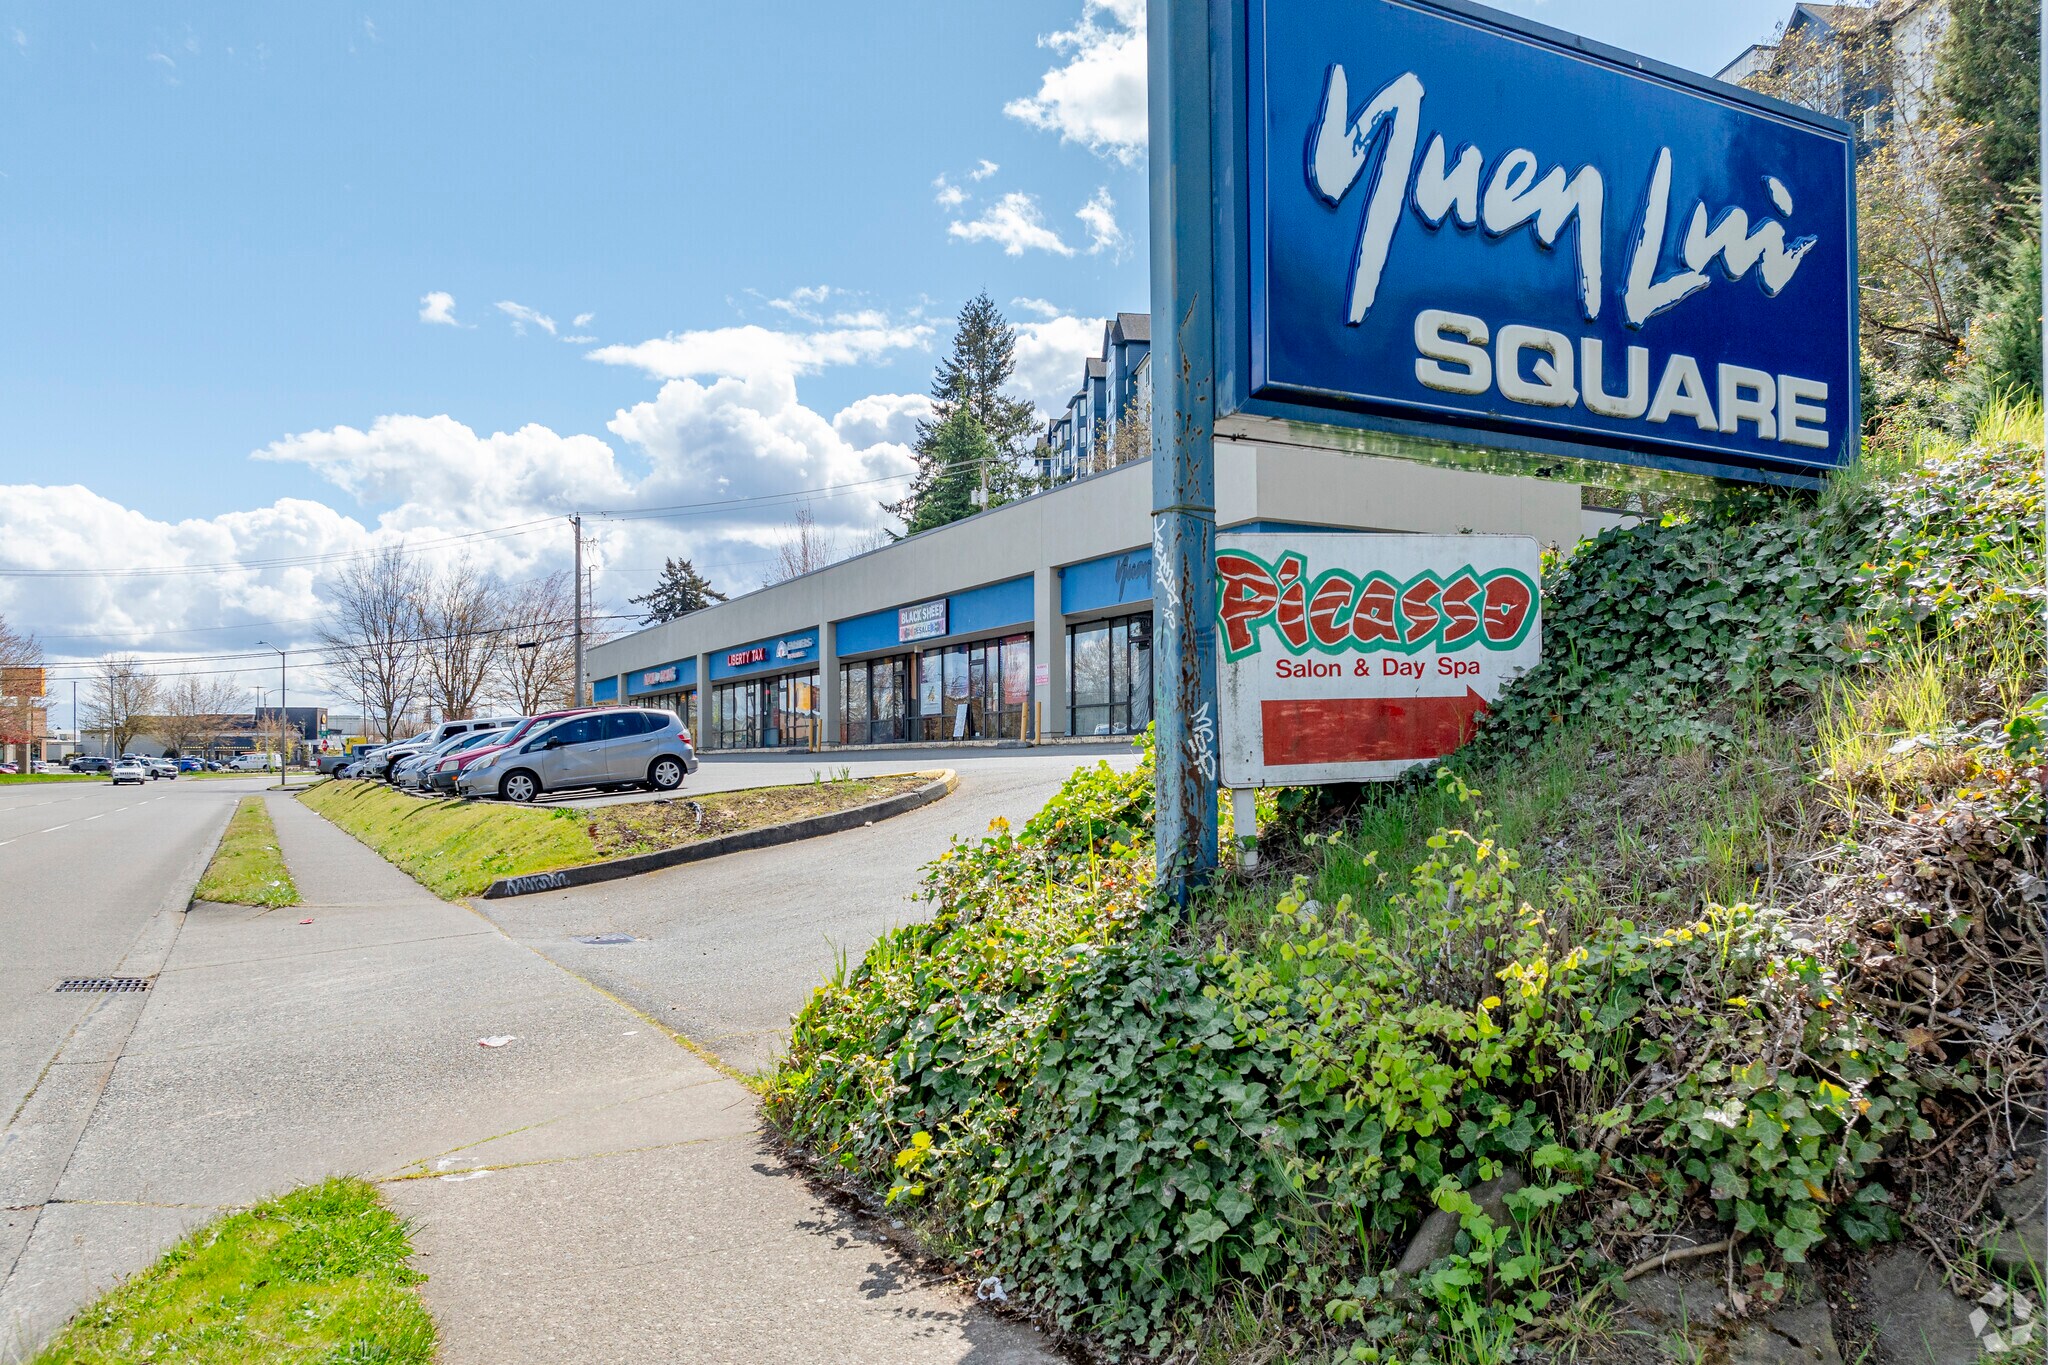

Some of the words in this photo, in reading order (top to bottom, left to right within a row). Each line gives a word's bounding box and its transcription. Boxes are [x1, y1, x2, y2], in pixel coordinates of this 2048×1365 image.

[1623, 146, 1817, 329] Lui
[1414, 309, 1829, 449] SQUARE
[901, 609, 922, 625] BLACK
[922, 602, 944, 620] SHEEP
[1216, 553, 1534, 657] Picasso
[728, 649, 750, 667] LIBERTY
[751, 647, 764, 662] TAX
[1275, 659, 1342, 679] Salon
[1353, 658, 1370, 677] &
[1382, 657, 1426, 679] Day
[1437, 656, 1481, 678] Spa
